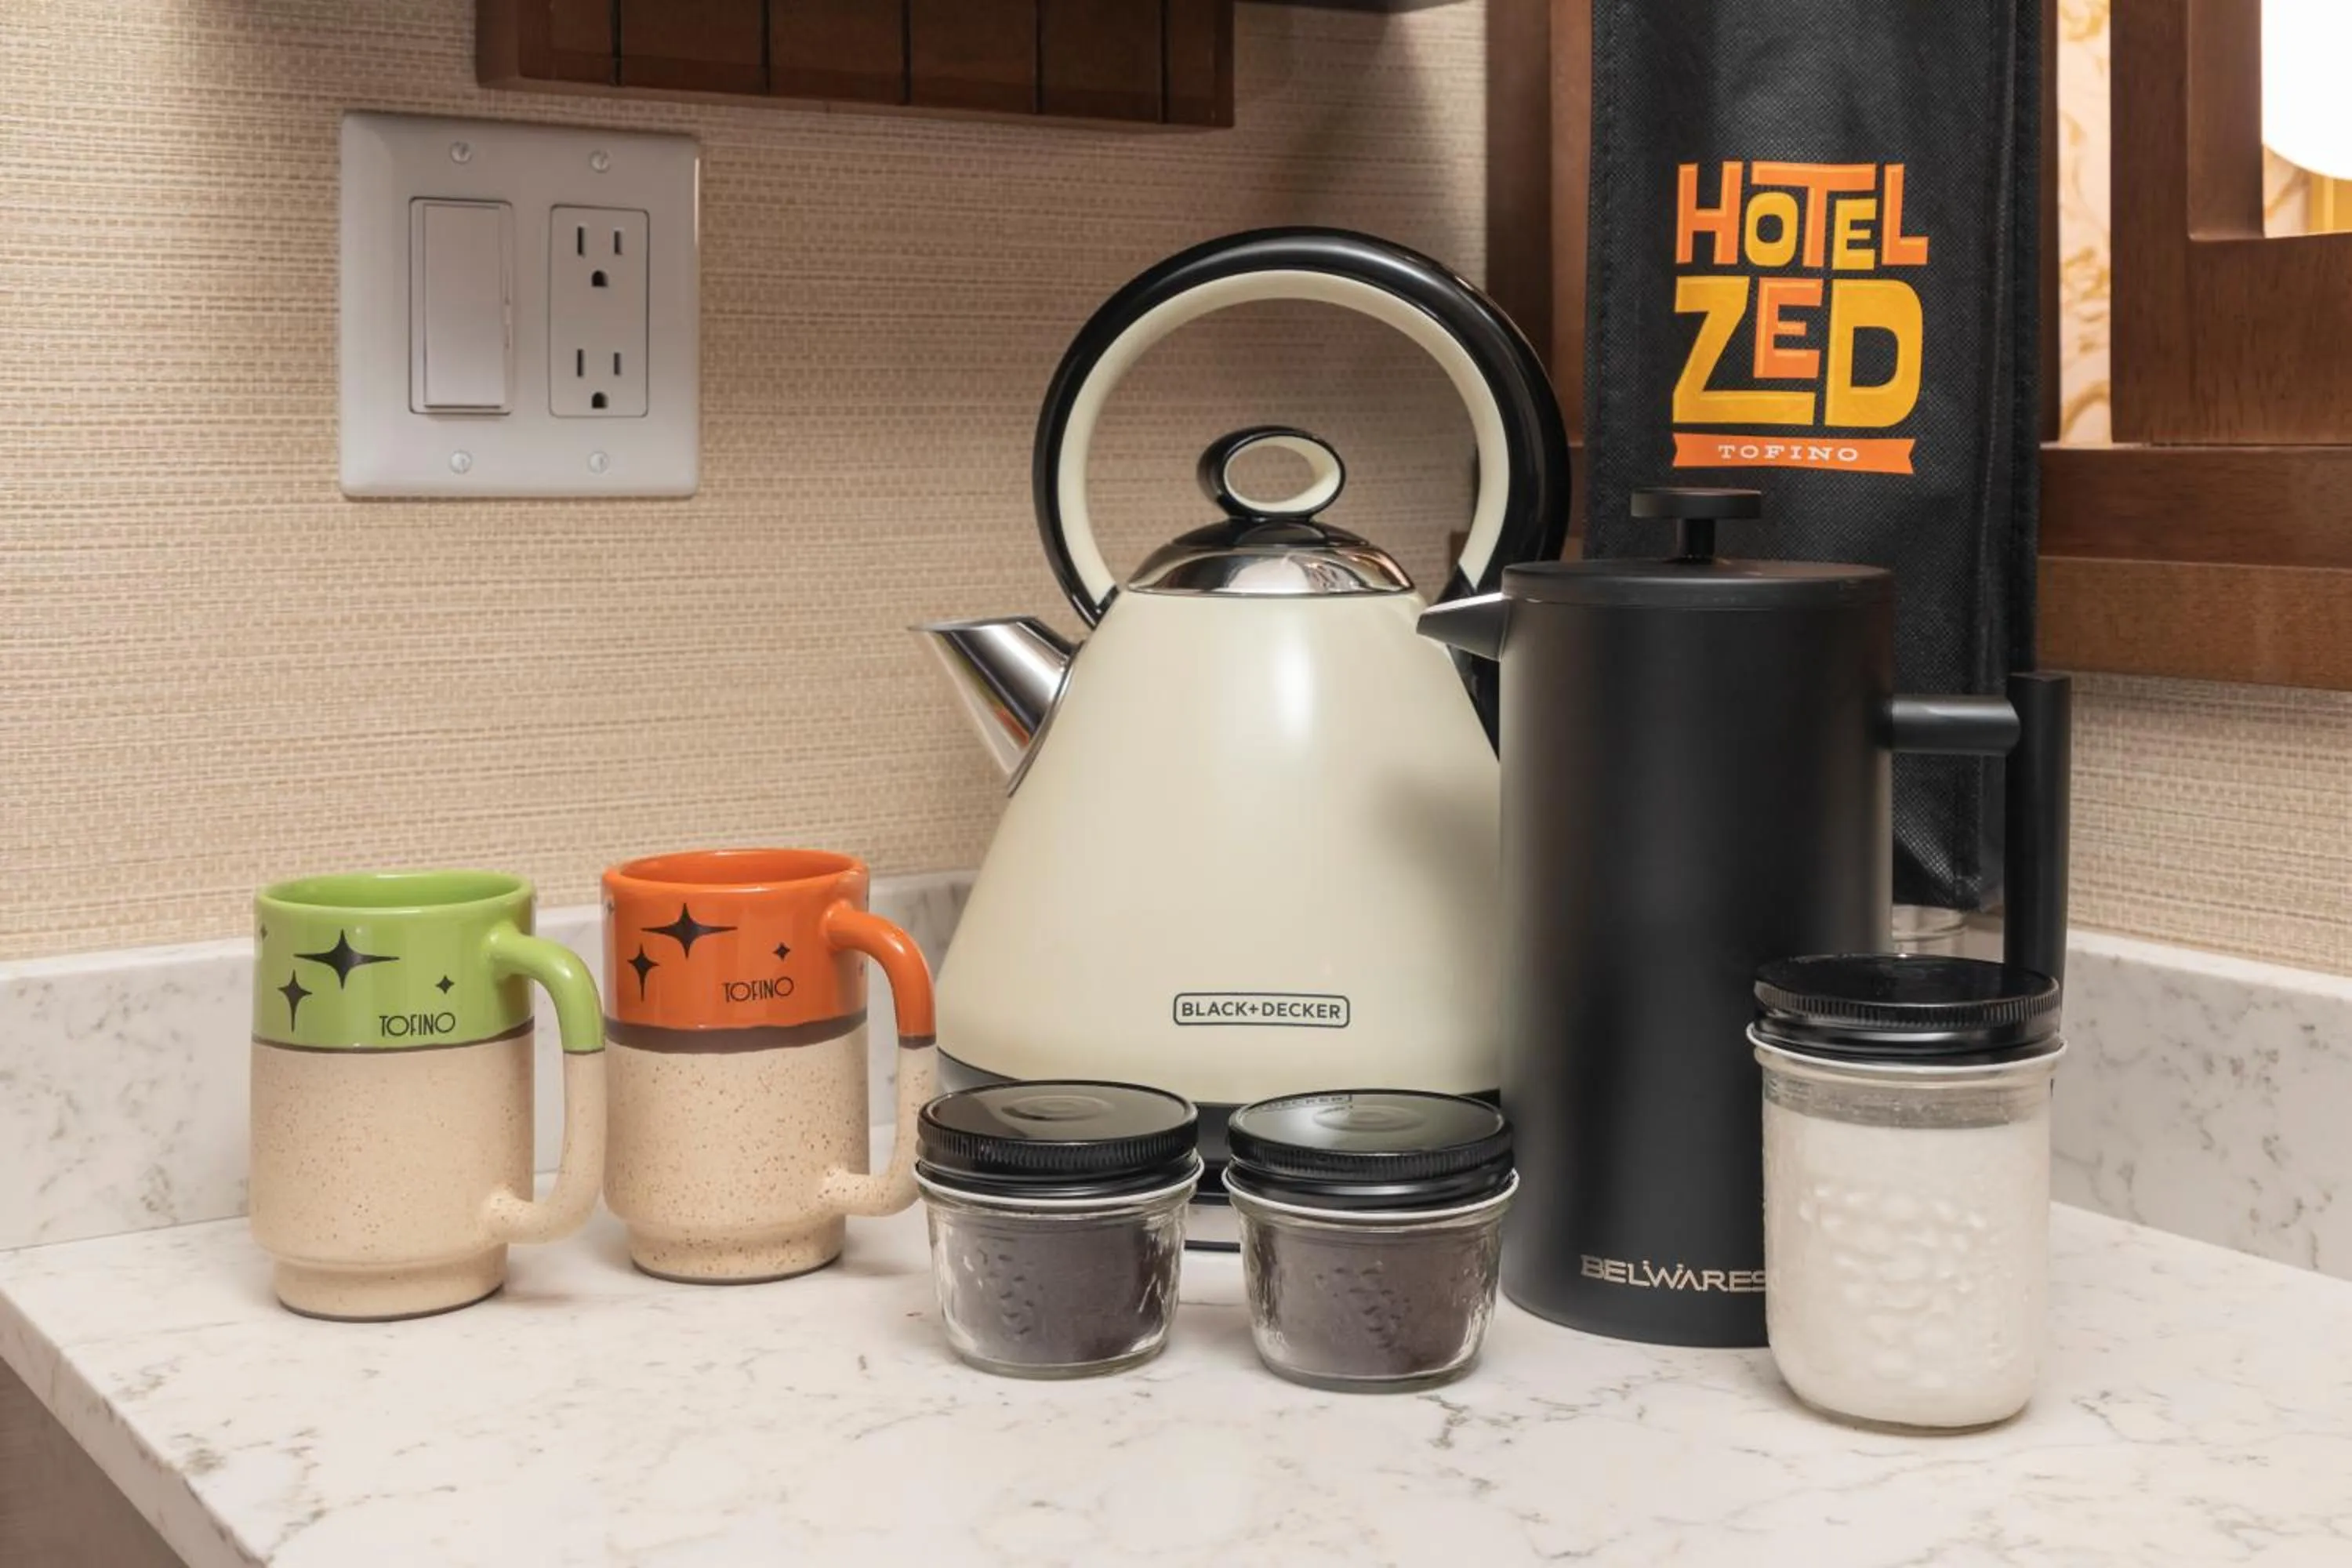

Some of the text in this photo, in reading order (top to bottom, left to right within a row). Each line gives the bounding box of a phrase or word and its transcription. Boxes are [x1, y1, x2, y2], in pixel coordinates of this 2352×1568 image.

[1676, 161, 1929, 270] HOTEL
[1672, 275, 1923, 428] ZED
[1718, 444, 1860, 463] TOFINO
[723, 976, 795, 1004] TOFINO
[1180, 1001, 1342, 1019] BLACK+DECKER
[379, 1012, 456, 1036] TOFINO
